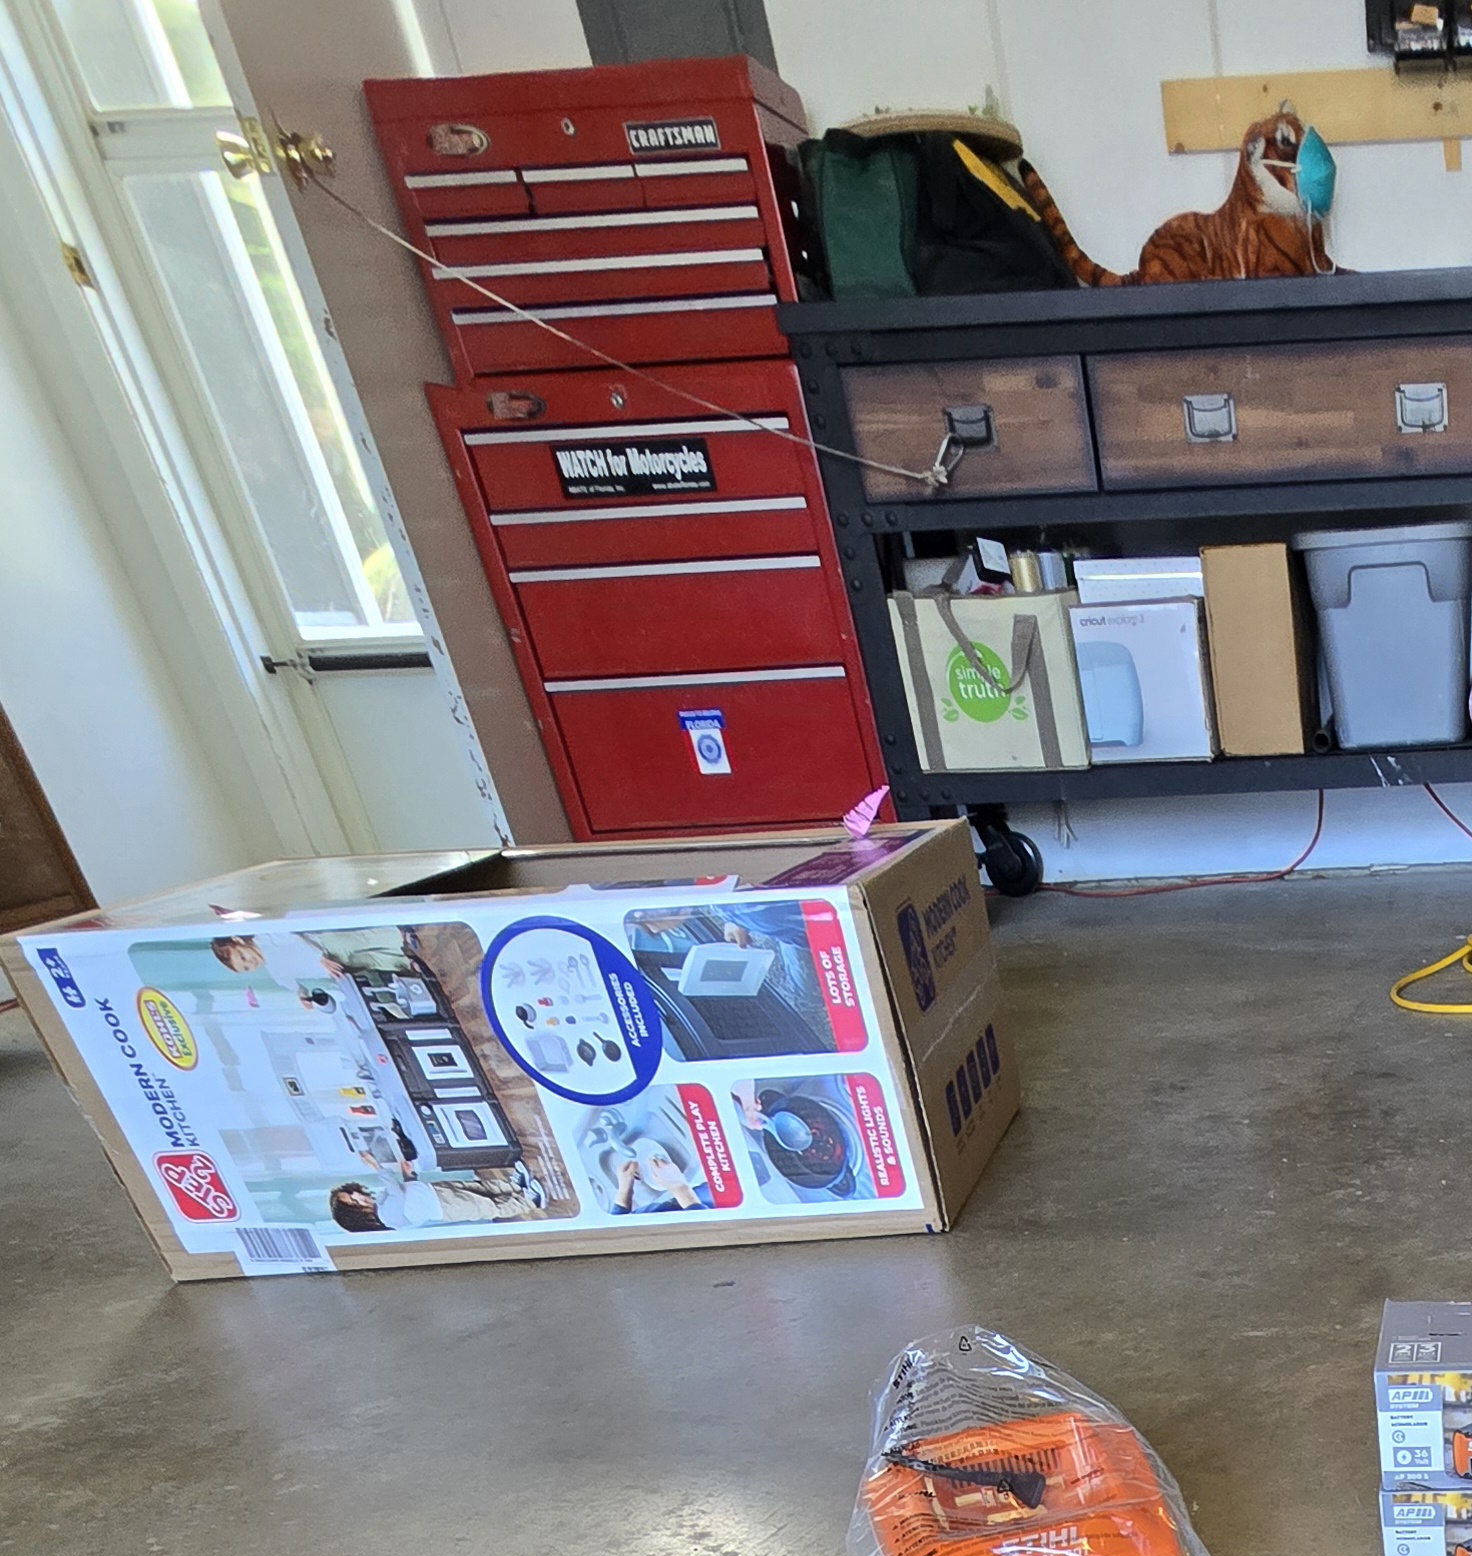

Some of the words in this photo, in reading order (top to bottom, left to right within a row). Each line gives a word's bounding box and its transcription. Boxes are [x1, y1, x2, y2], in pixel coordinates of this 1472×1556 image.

[629, 124, 717, 148] CRAFTSMAN
[556, 449, 609, 478] WATCH
[606, 448, 628, 476] for
[625, 445, 708, 480] Motorcycles
[1079, 615, 1106, 627] cricut
[955, 663, 1001, 681] simle
[818, 950, 833, 971] OF
[830, 946, 856, 1007] STORAGE
[608, 972, 642, 1047] ACCESSORIES
[623, 981, 649, 1037] INCLUDED
[825, 971, 843, 1005] LOTS
[93, 997, 137, 1059] COOK
[159, 1001, 193, 1056] Exclusive
[129, 1062, 185, 1148] MODERN
[154, 1077, 200, 1147] KITCHEN
[688, 1100, 706, 1131] PLAY
[855, 1085, 875, 1127] LIGHTS
[873, 1105, 894, 1154] SOUNDS
[698, 1132, 725, 1193] COMPLETE
[707, 1121, 731, 1172] KITCHEN
[866, 1129, 890, 1186] REALISTIC
[161, 1163, 234, 1218] STEP
[1414, 1449, 1429, 1459] 36
